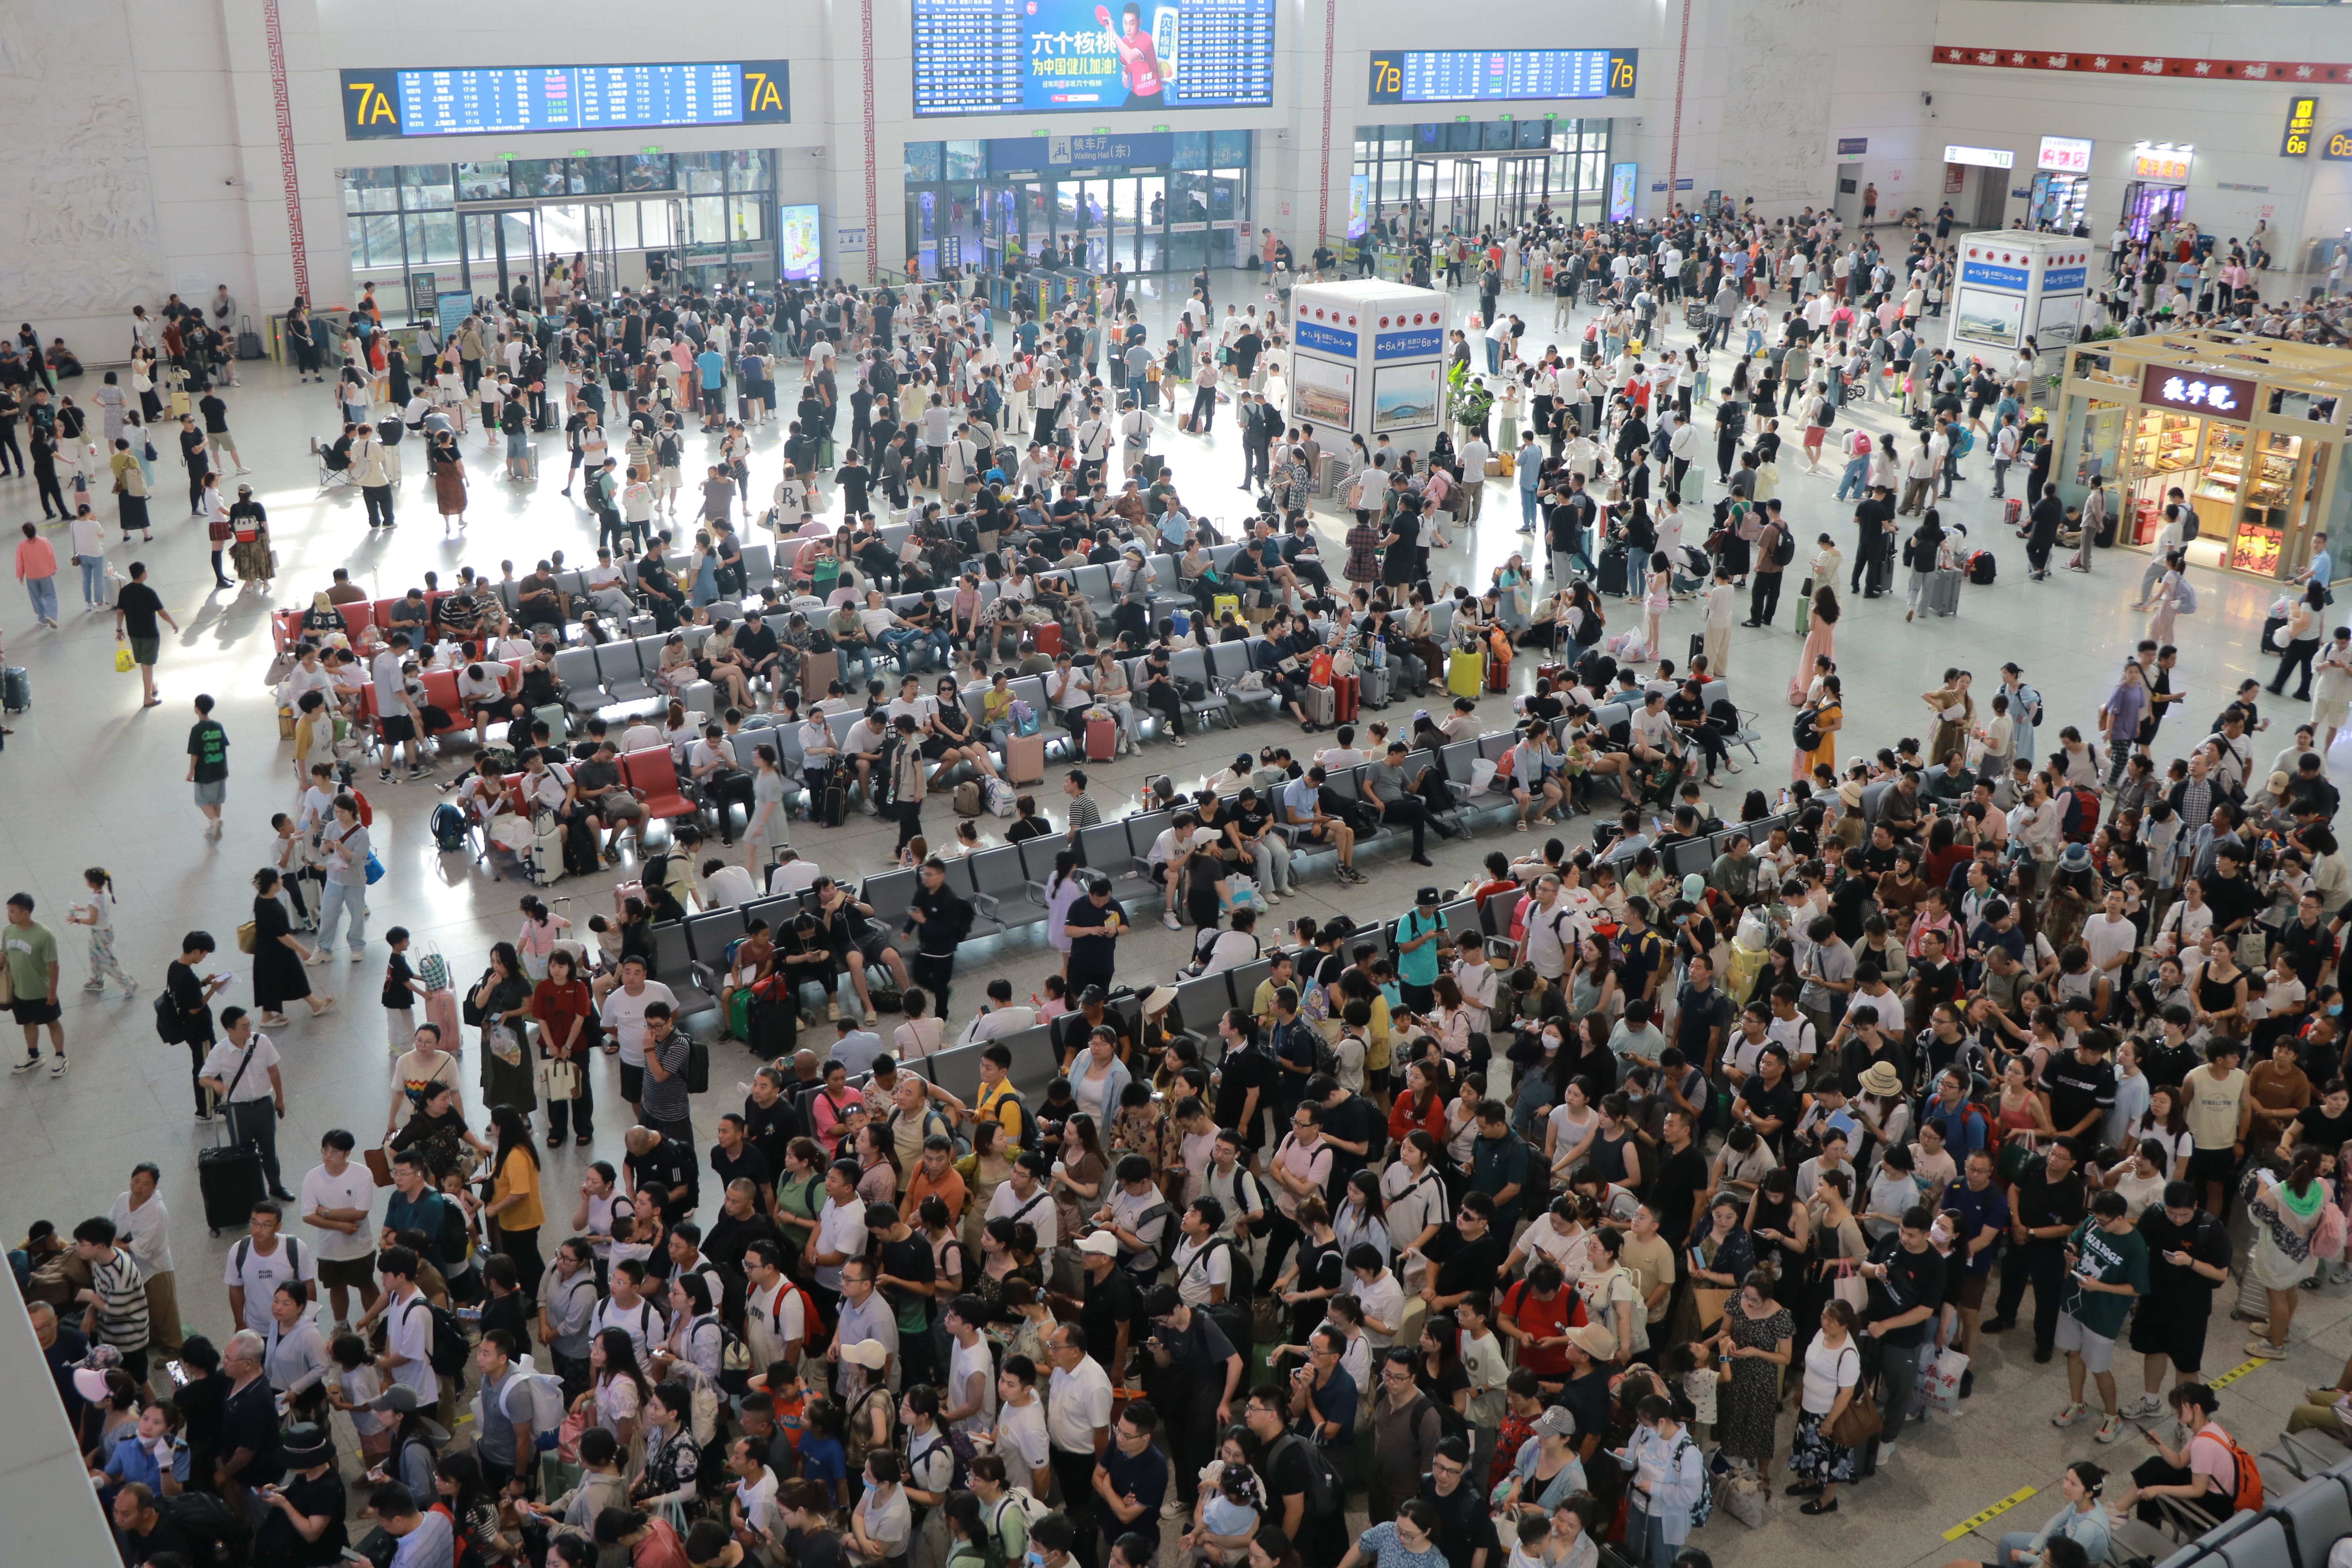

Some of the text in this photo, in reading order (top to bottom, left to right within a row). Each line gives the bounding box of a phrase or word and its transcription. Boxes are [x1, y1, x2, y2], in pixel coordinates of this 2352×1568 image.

[1032, 31, 1116, 54] 六个核桃
[1159, 17, 1171, 56] 六个核桃
[1032, 58, 1116, 76] 为中国健儿加油!
[1611, 58, 1633, 88] 7B
[1141, 72, 1153, 82] 许昕
[1374, 60, 1401, 94] 7B
[746, 73, 782, 111] 7A
[349, 83, 396, 125] 7A
[2290, 118, 2313, 128] 检票口
[1073, 137, 1131, 158] 候车厅 (东)
[2287, 135, 2307, 154] 6B
[2330, 134, 2352, 156] 6B
[1073, 152, 1096, 161] Waiting
[2041, 149, 2087, 168] 购物店
[2136, 156, 2187, 179] 便利超市
[1322, 333, 1333, 341] 检票口
[1333, 337, 1345, 346] 3A-5A
[1385, 342, 1396, 351] 6A
[1421, 338, 1431, 347] 6B
[782, 487, 793, 504] R
